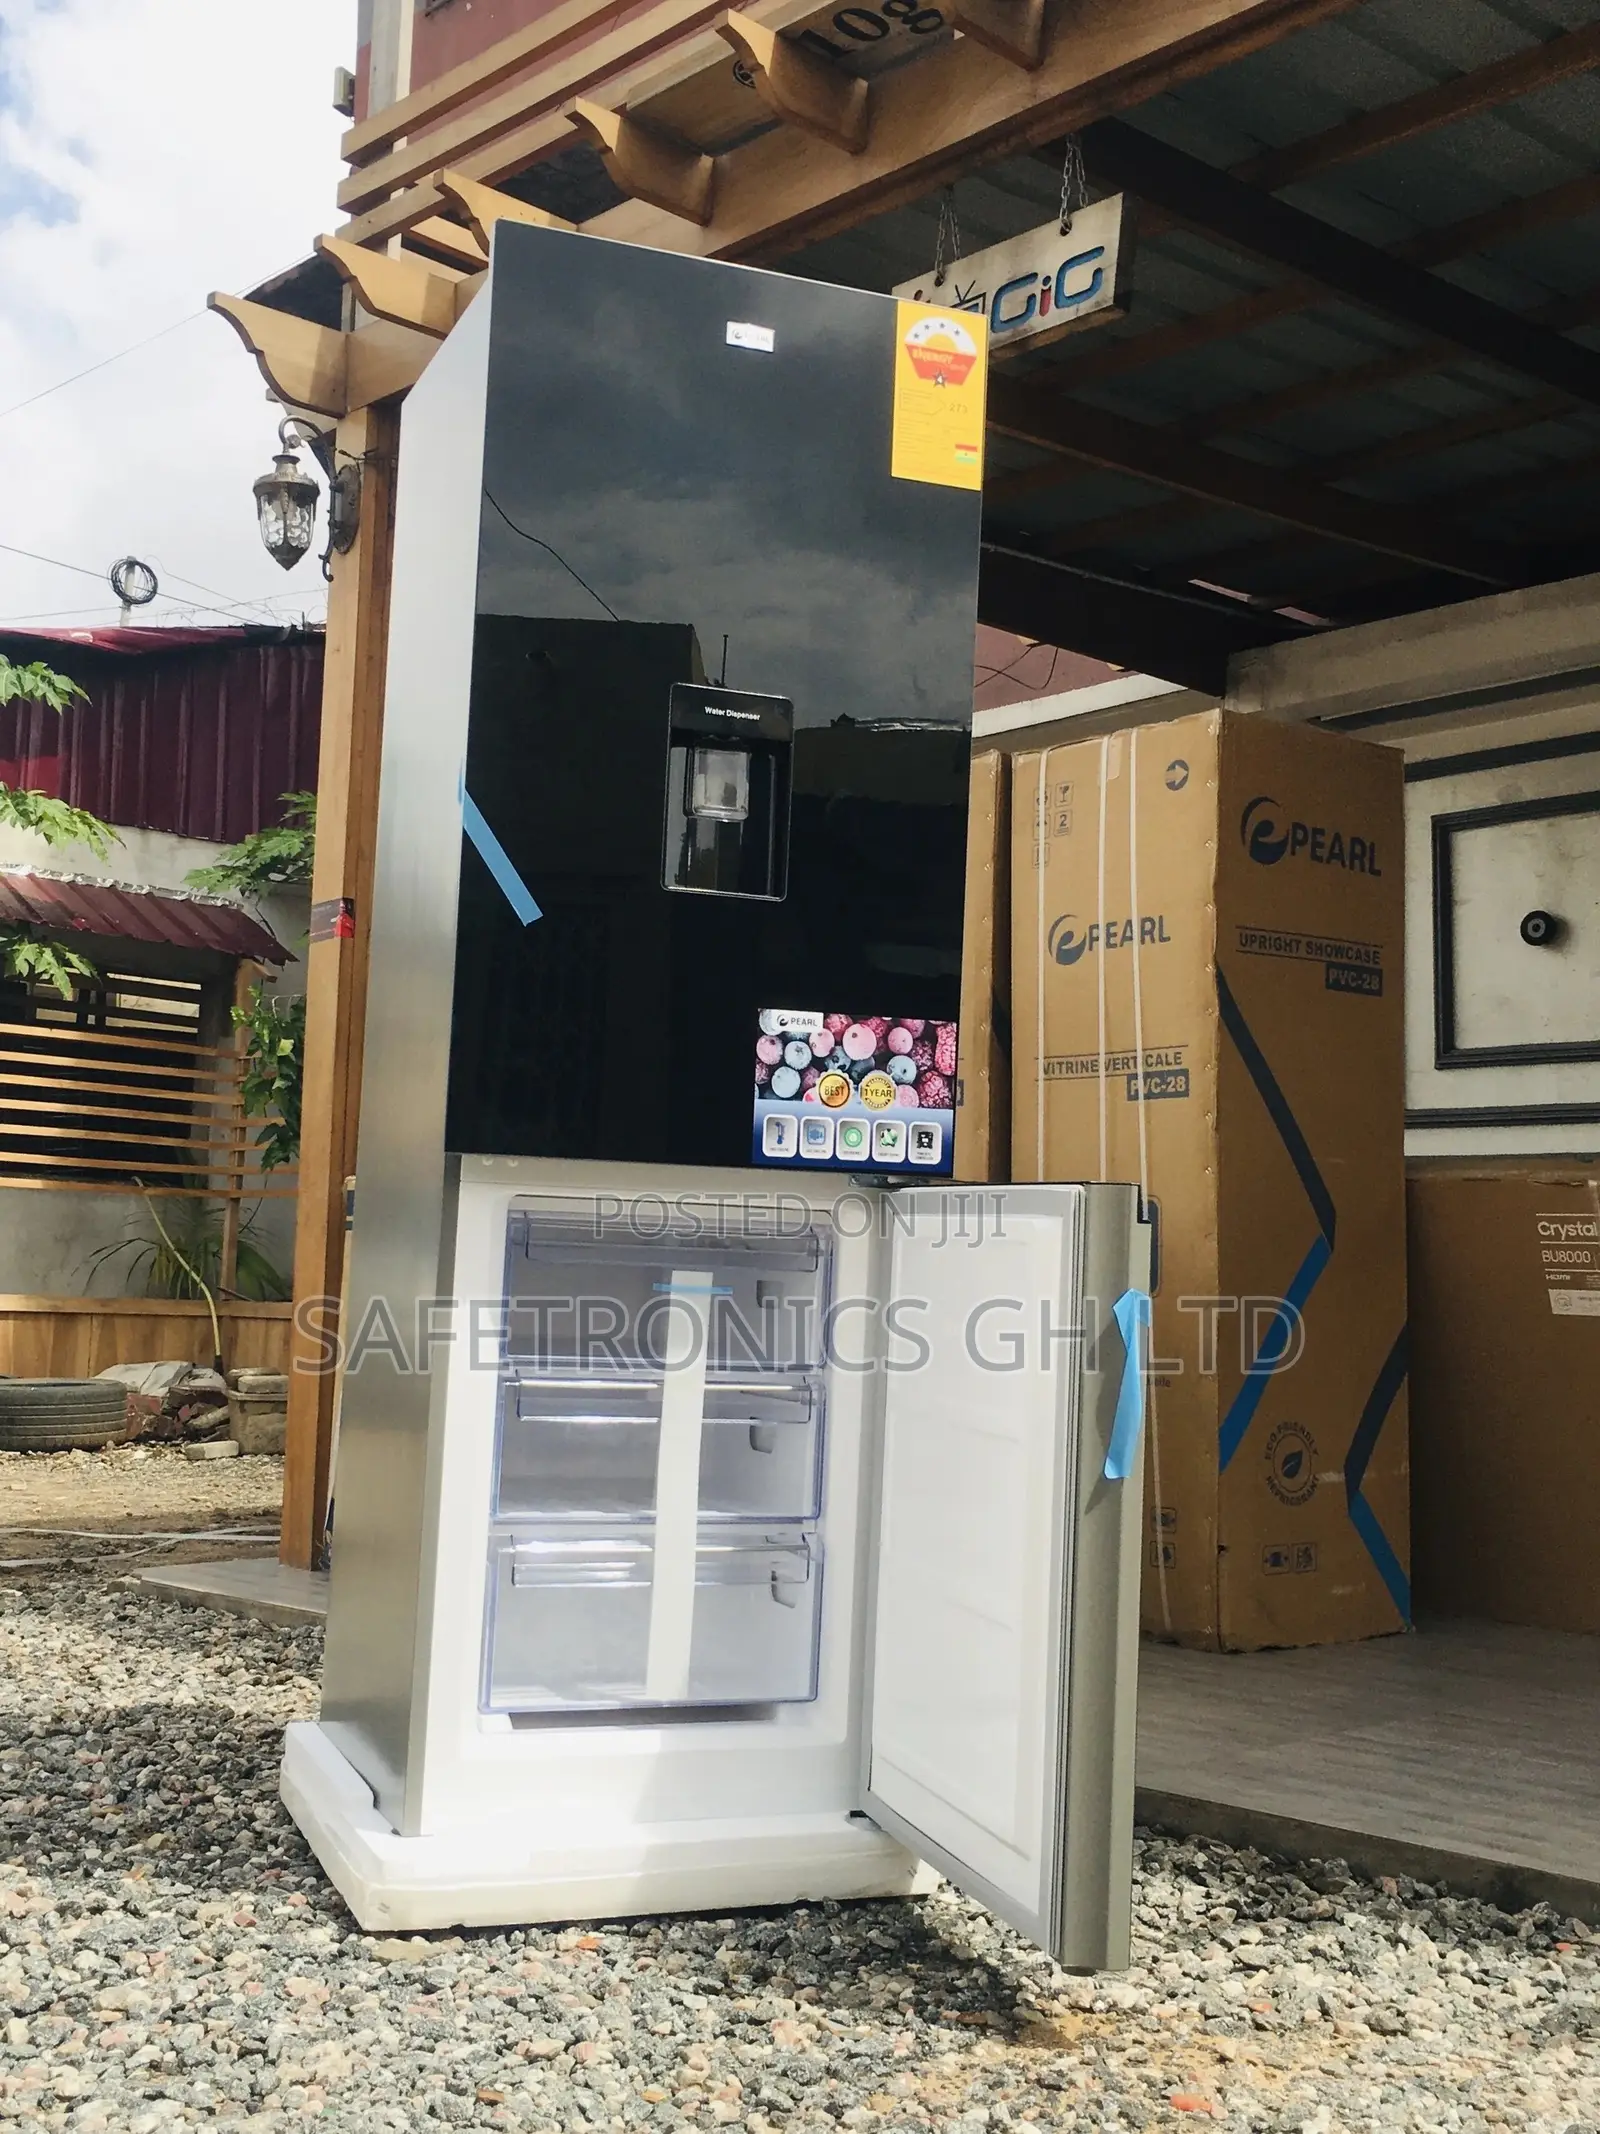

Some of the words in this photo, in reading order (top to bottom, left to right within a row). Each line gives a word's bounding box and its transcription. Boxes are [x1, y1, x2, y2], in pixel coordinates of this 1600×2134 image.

[704, 706, 726, 716] Water
[726, 709, 761, 721] Dispenser
[1059, 813, 1068, 827] 2
[1291, 821, 1382, 877] PEARL
[1088, 914, 1171, 951] PEARL
[1239, 932, 1302, 952] UPRIGHT
[1305, 941, 1381, 966] SHOWCASE
[1328, 968, 1381, 990] PVC-28
[790, 1017, 818, 1027] PEARL
[1043, 1058, 1100, 1076] VITRINE
[1104, 1051, 1183, 1072] VERTCALE
[824, 1086, 846, 1097] BEST
[1130, 1075, 1187, 1096] PVC-28
[1537, 1220, 1599, 1241] Crystal
[1541, 1249, 1592, 1263] BU8000
